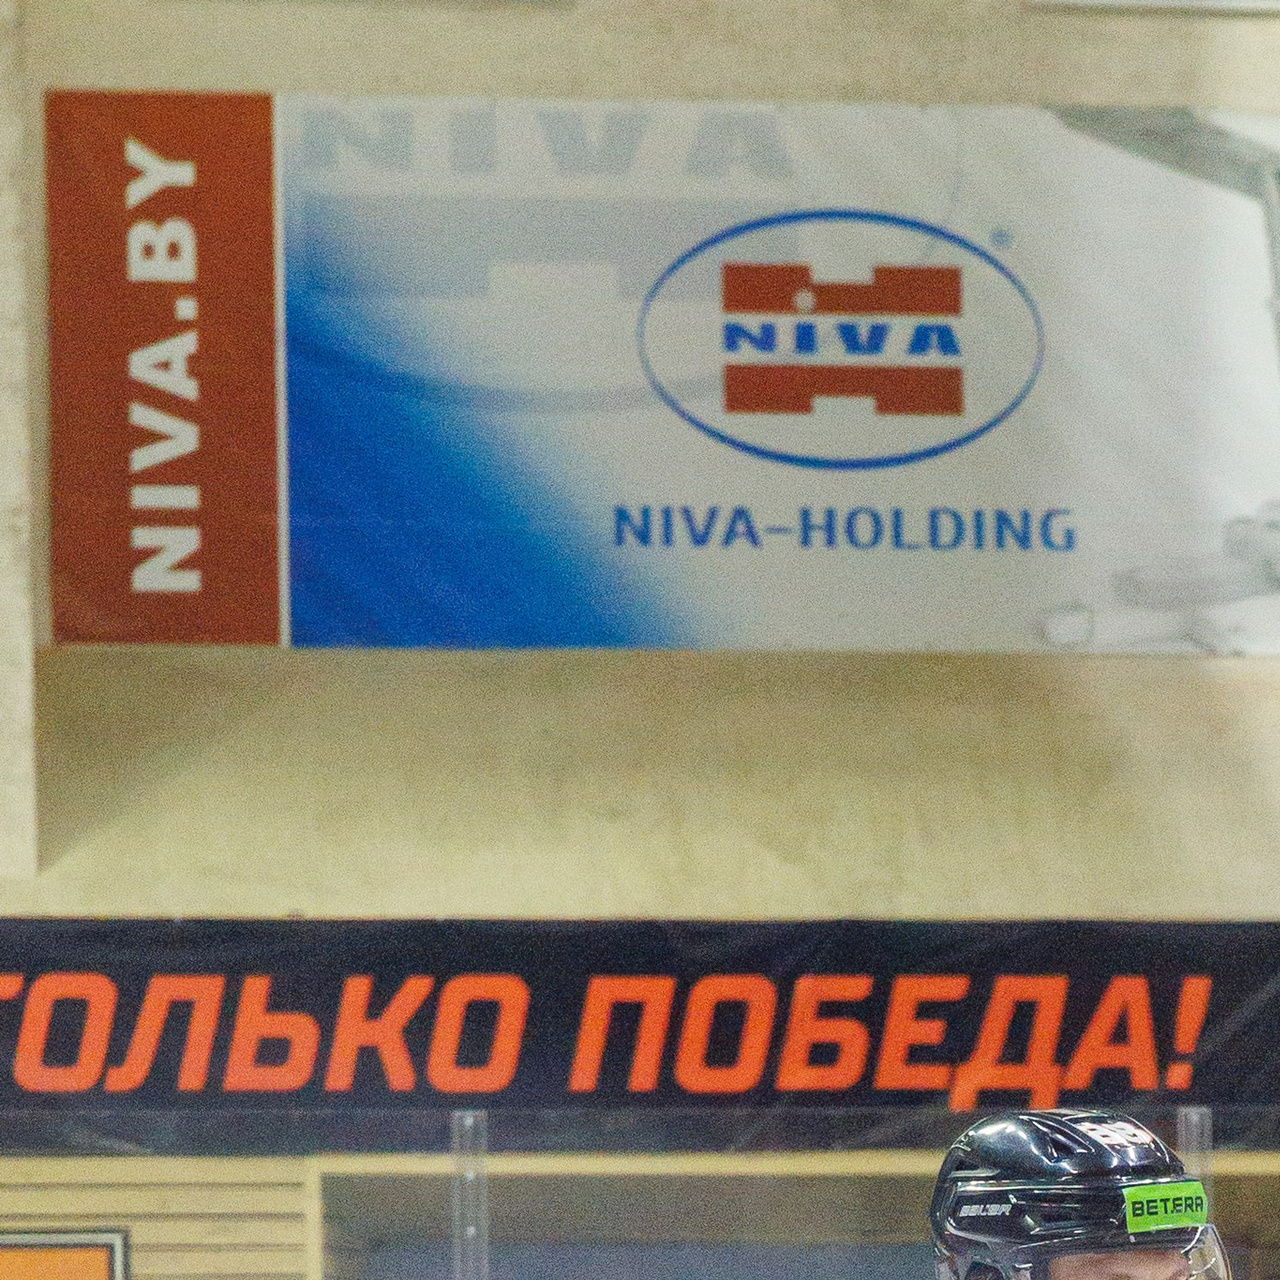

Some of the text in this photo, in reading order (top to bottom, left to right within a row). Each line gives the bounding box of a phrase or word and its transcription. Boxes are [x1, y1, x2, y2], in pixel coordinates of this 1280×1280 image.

[125, 137, 203, 594] NIVA.BY
[722, 323, 961, 357] NIVA
[613, 506, 1077, 553] NIVA-HOLDING
[568, 974, 1212, 1112] ПОБЕДА!
